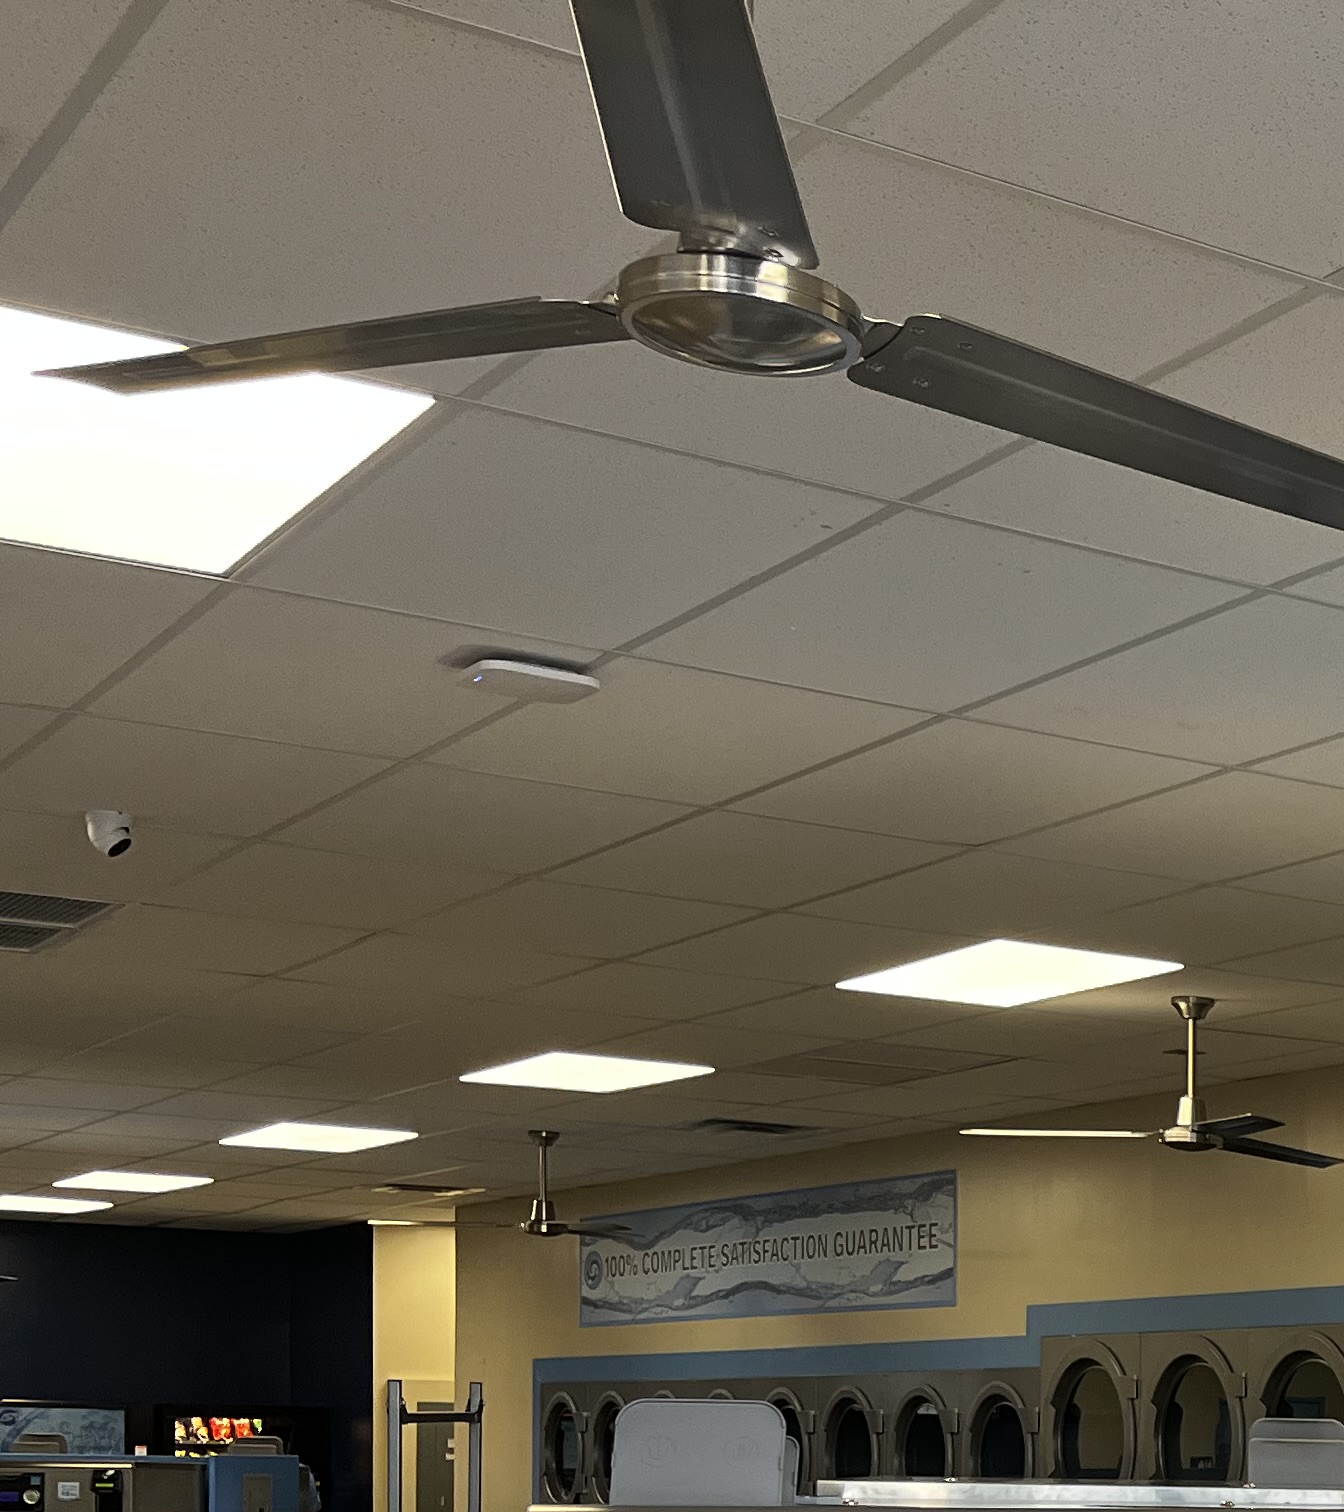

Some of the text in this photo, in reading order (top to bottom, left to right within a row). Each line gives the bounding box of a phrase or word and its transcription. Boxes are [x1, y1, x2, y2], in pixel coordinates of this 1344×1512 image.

[605, 1222, 939, 1278] 100% COMPLETE SATISFACTION GUARANTEE
